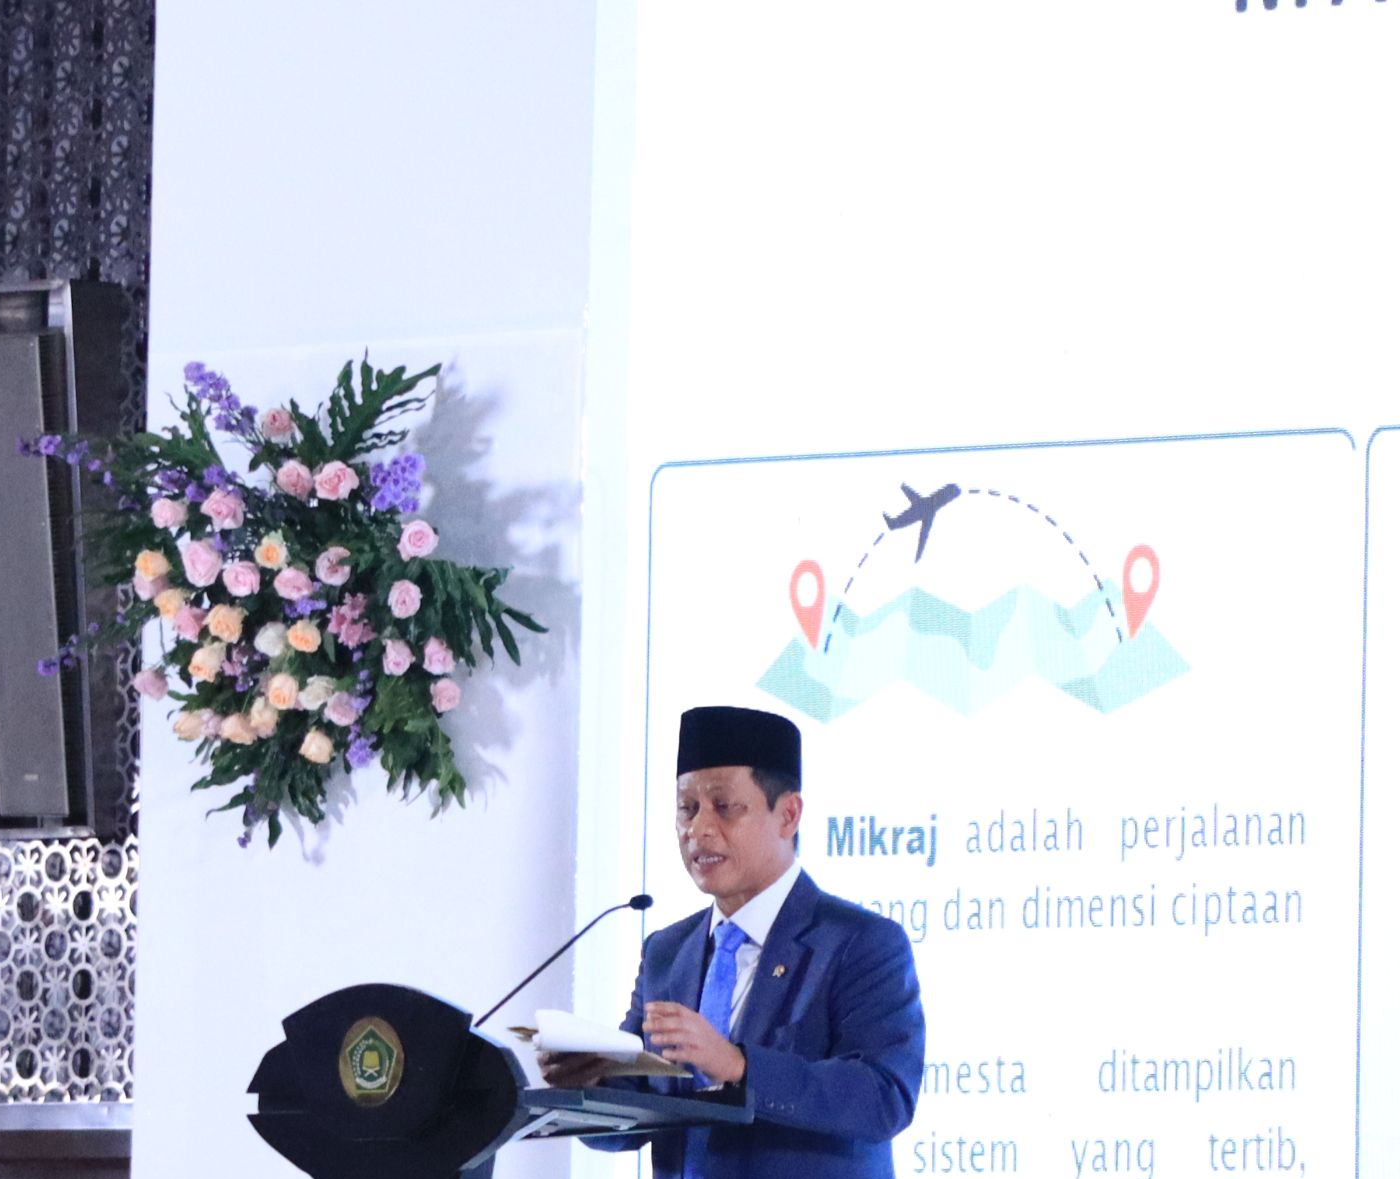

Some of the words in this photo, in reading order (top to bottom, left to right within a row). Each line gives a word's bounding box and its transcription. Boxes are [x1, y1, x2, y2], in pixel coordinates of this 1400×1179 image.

[826, 813, 938, 867] Mikraj
[965, 808, 1083, 853] adalah
[1121, 803, 1306, 862] perjalanan
[943, 887, 1005, 931] dan
[1022, 884, 1156, 929] dimensi
[1171, 882, 1302, 936] ciptaan
[922, 1056, 1027, 1095] mesta
[1098, 1047, 1296, 1104] ditampilkan
[913, 1130, 1018, 1174] sistem
[1207, 1125, 1306, 1179] tertib,
